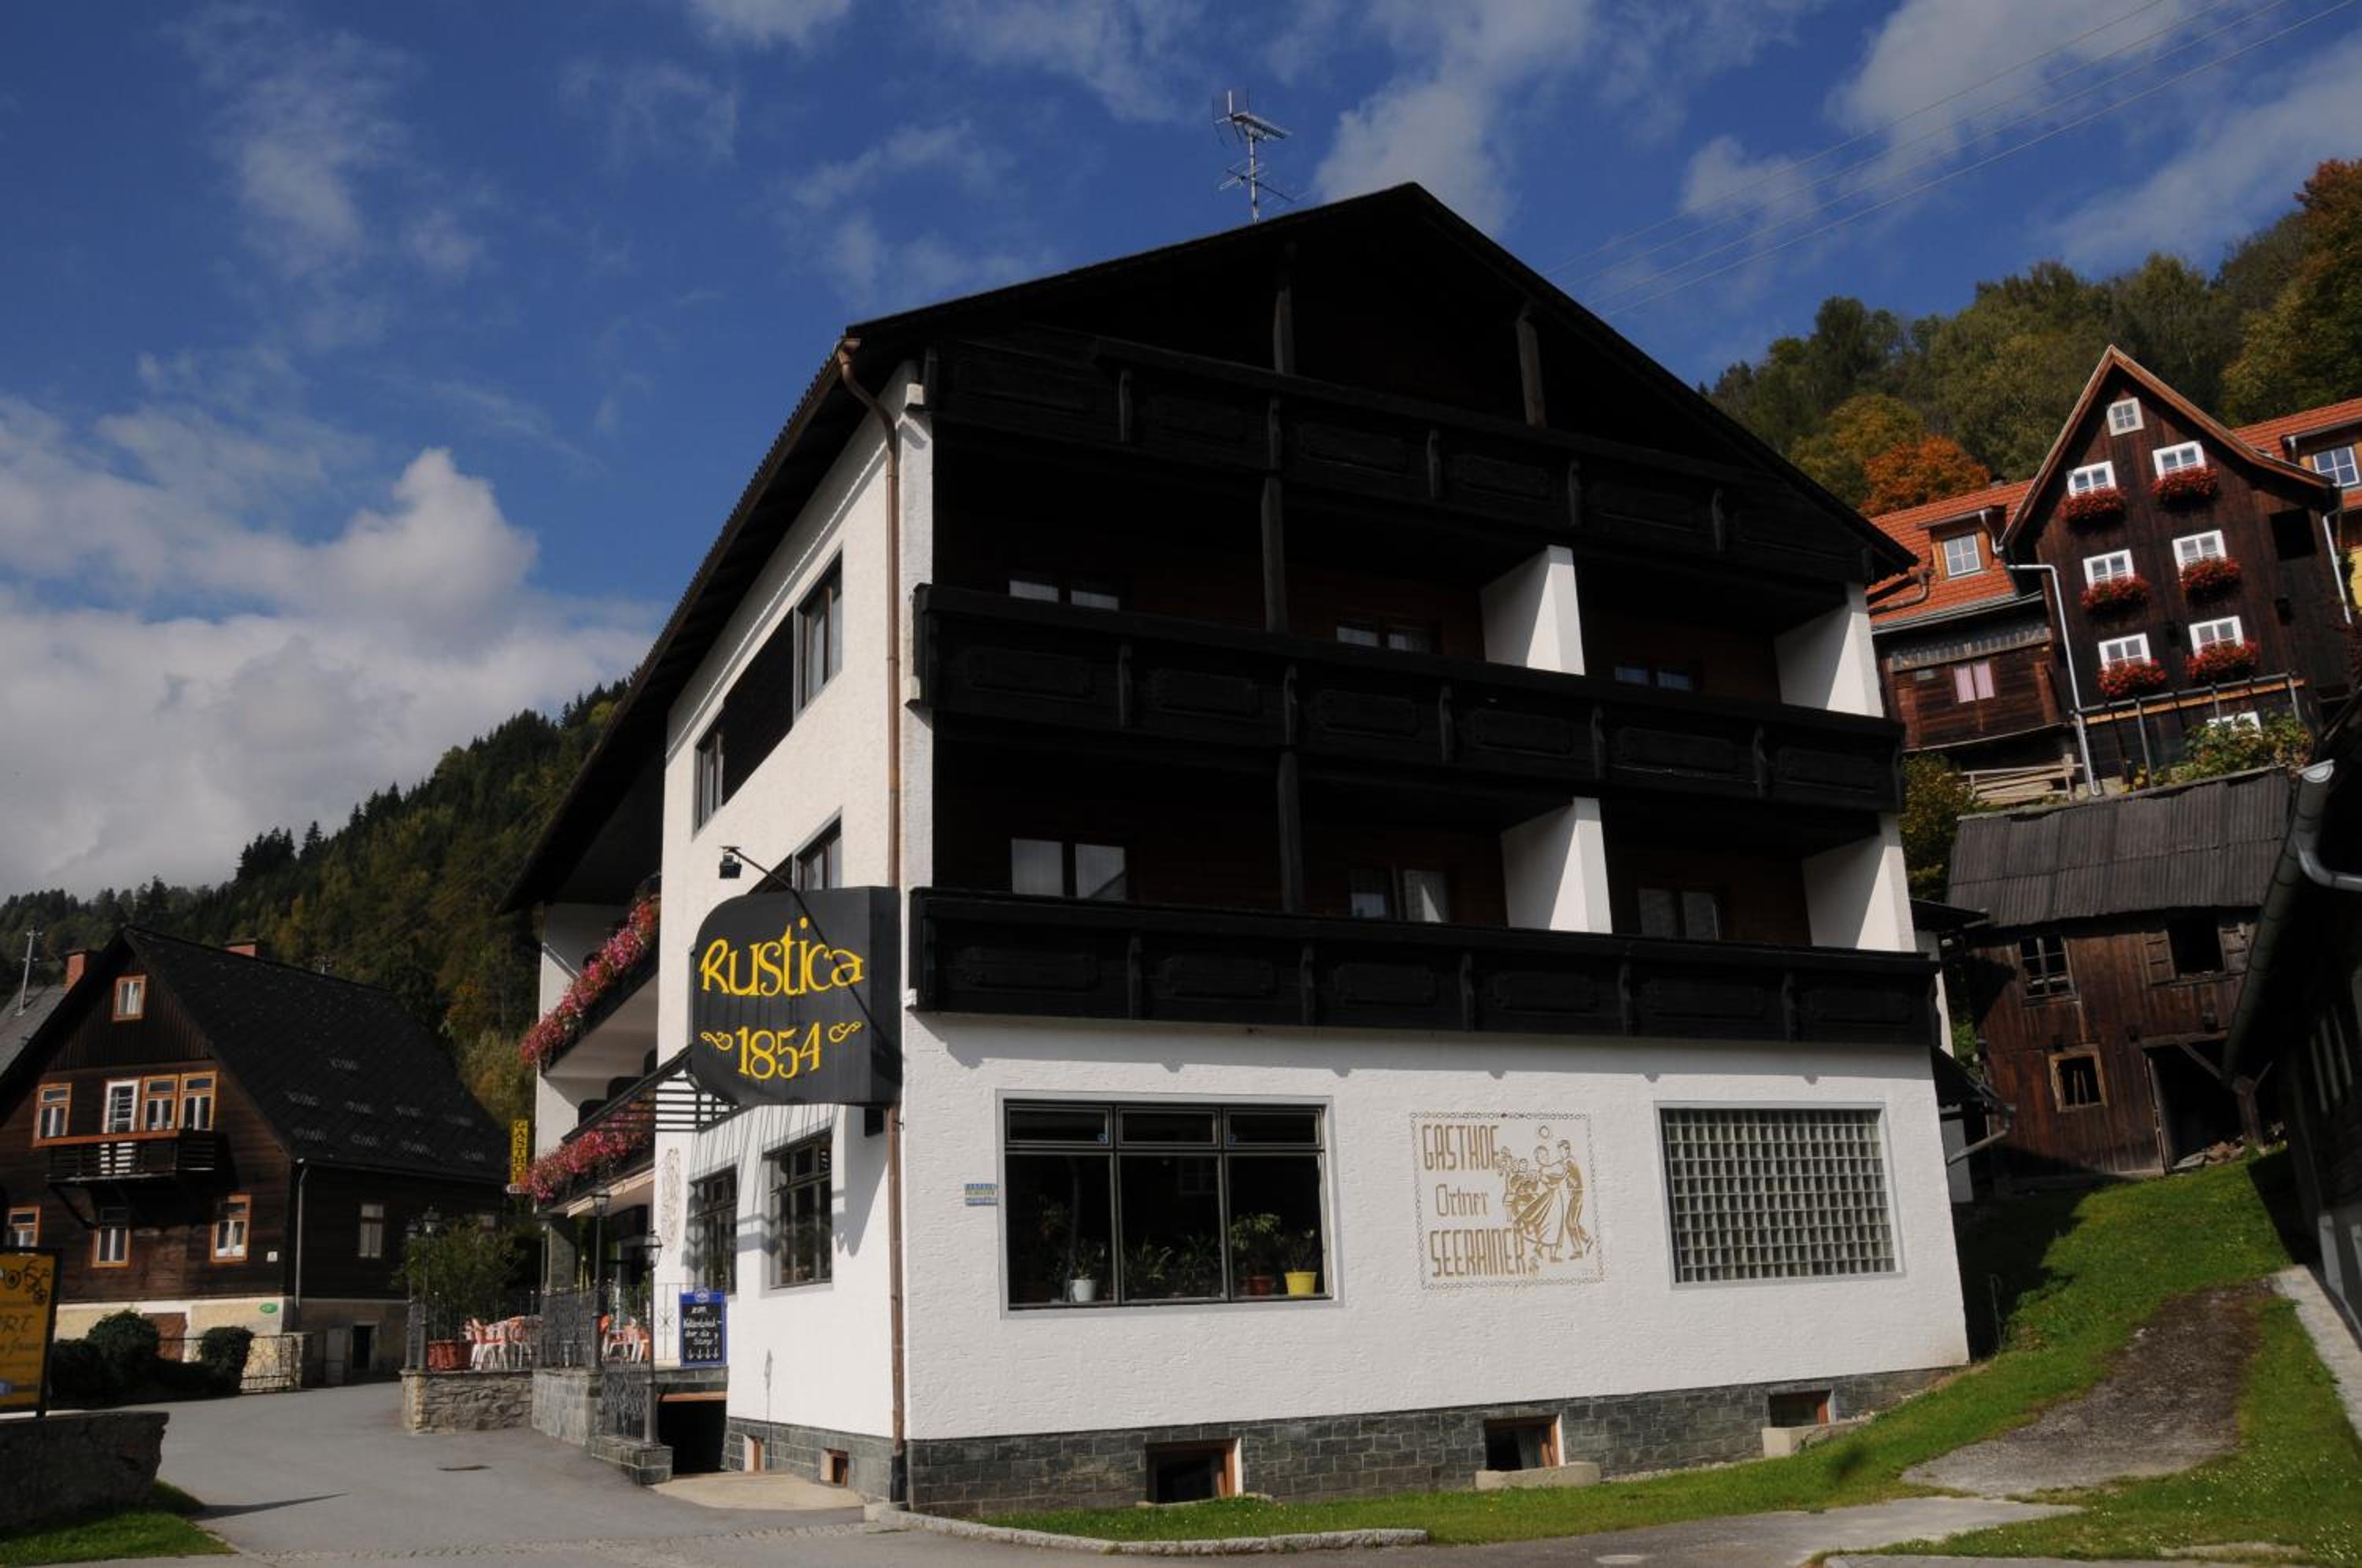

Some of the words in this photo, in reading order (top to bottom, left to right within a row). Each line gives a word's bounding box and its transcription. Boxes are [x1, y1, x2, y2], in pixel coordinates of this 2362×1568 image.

[700, 917, 864, 997] Rustica
[735, 1023, 820, 1079] 1854
[515, 1122, 526, 1184] GASTHO
[1422, 1124, 1500, 1170] GASTHOF
[1429, 1227, 1527, 1278] SEERAINER
